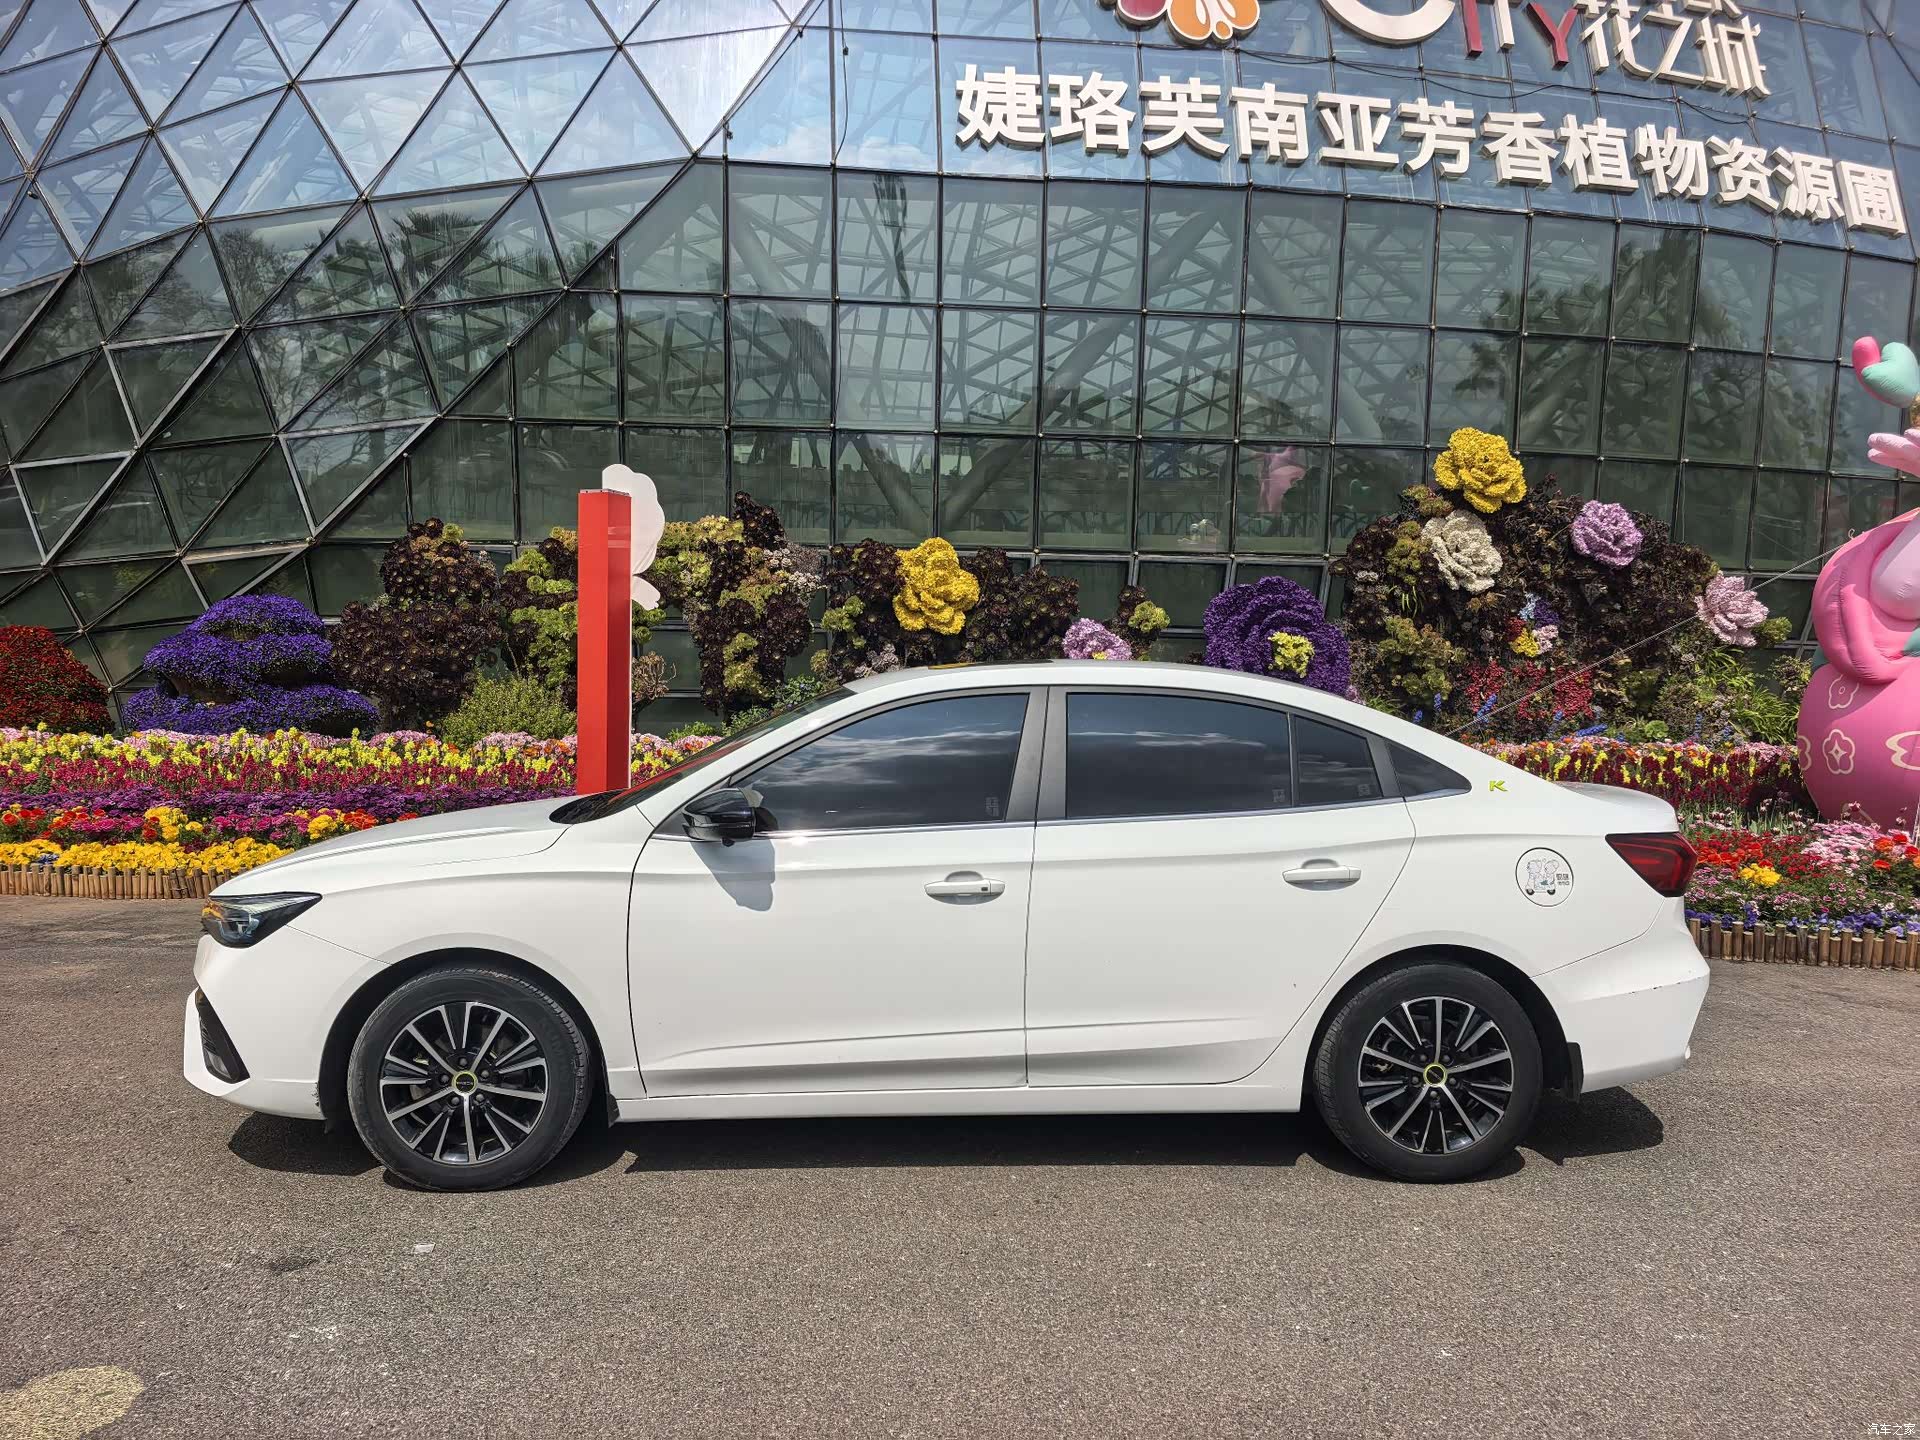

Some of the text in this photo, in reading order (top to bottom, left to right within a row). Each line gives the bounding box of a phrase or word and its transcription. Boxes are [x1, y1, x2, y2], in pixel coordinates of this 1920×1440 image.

[1579, 0, 1772, 97] 花之城
[956, 64, 1907, 238] 婕珞芙南亚芳香植物资源圃
